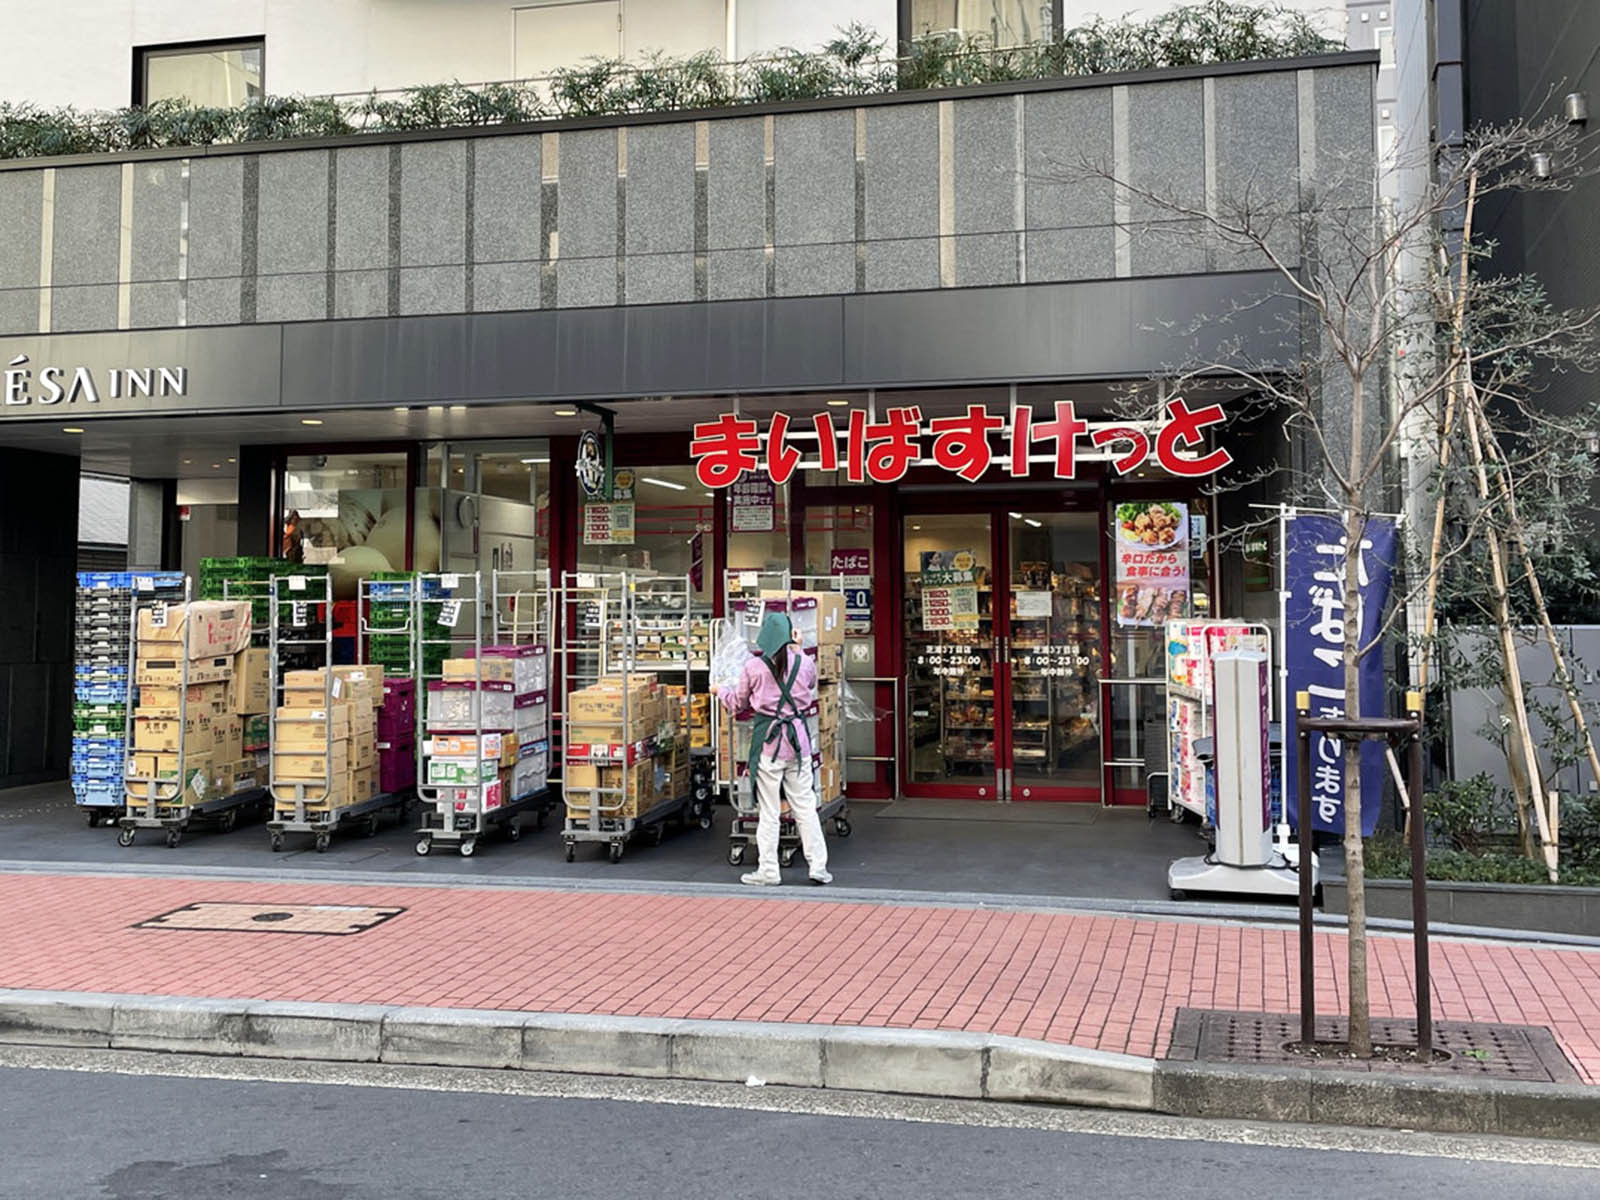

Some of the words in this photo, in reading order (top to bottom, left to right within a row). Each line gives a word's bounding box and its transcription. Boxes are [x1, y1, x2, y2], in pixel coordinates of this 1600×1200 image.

[0, 353, 99, 405] ÉSA
[108, 366, 188, 398] INN
[690, 400, 1235, 489] まいばすけっと
[832, 555, 869, 569] たばこ
[1121, 553, 1177, 564] 辛口だから
